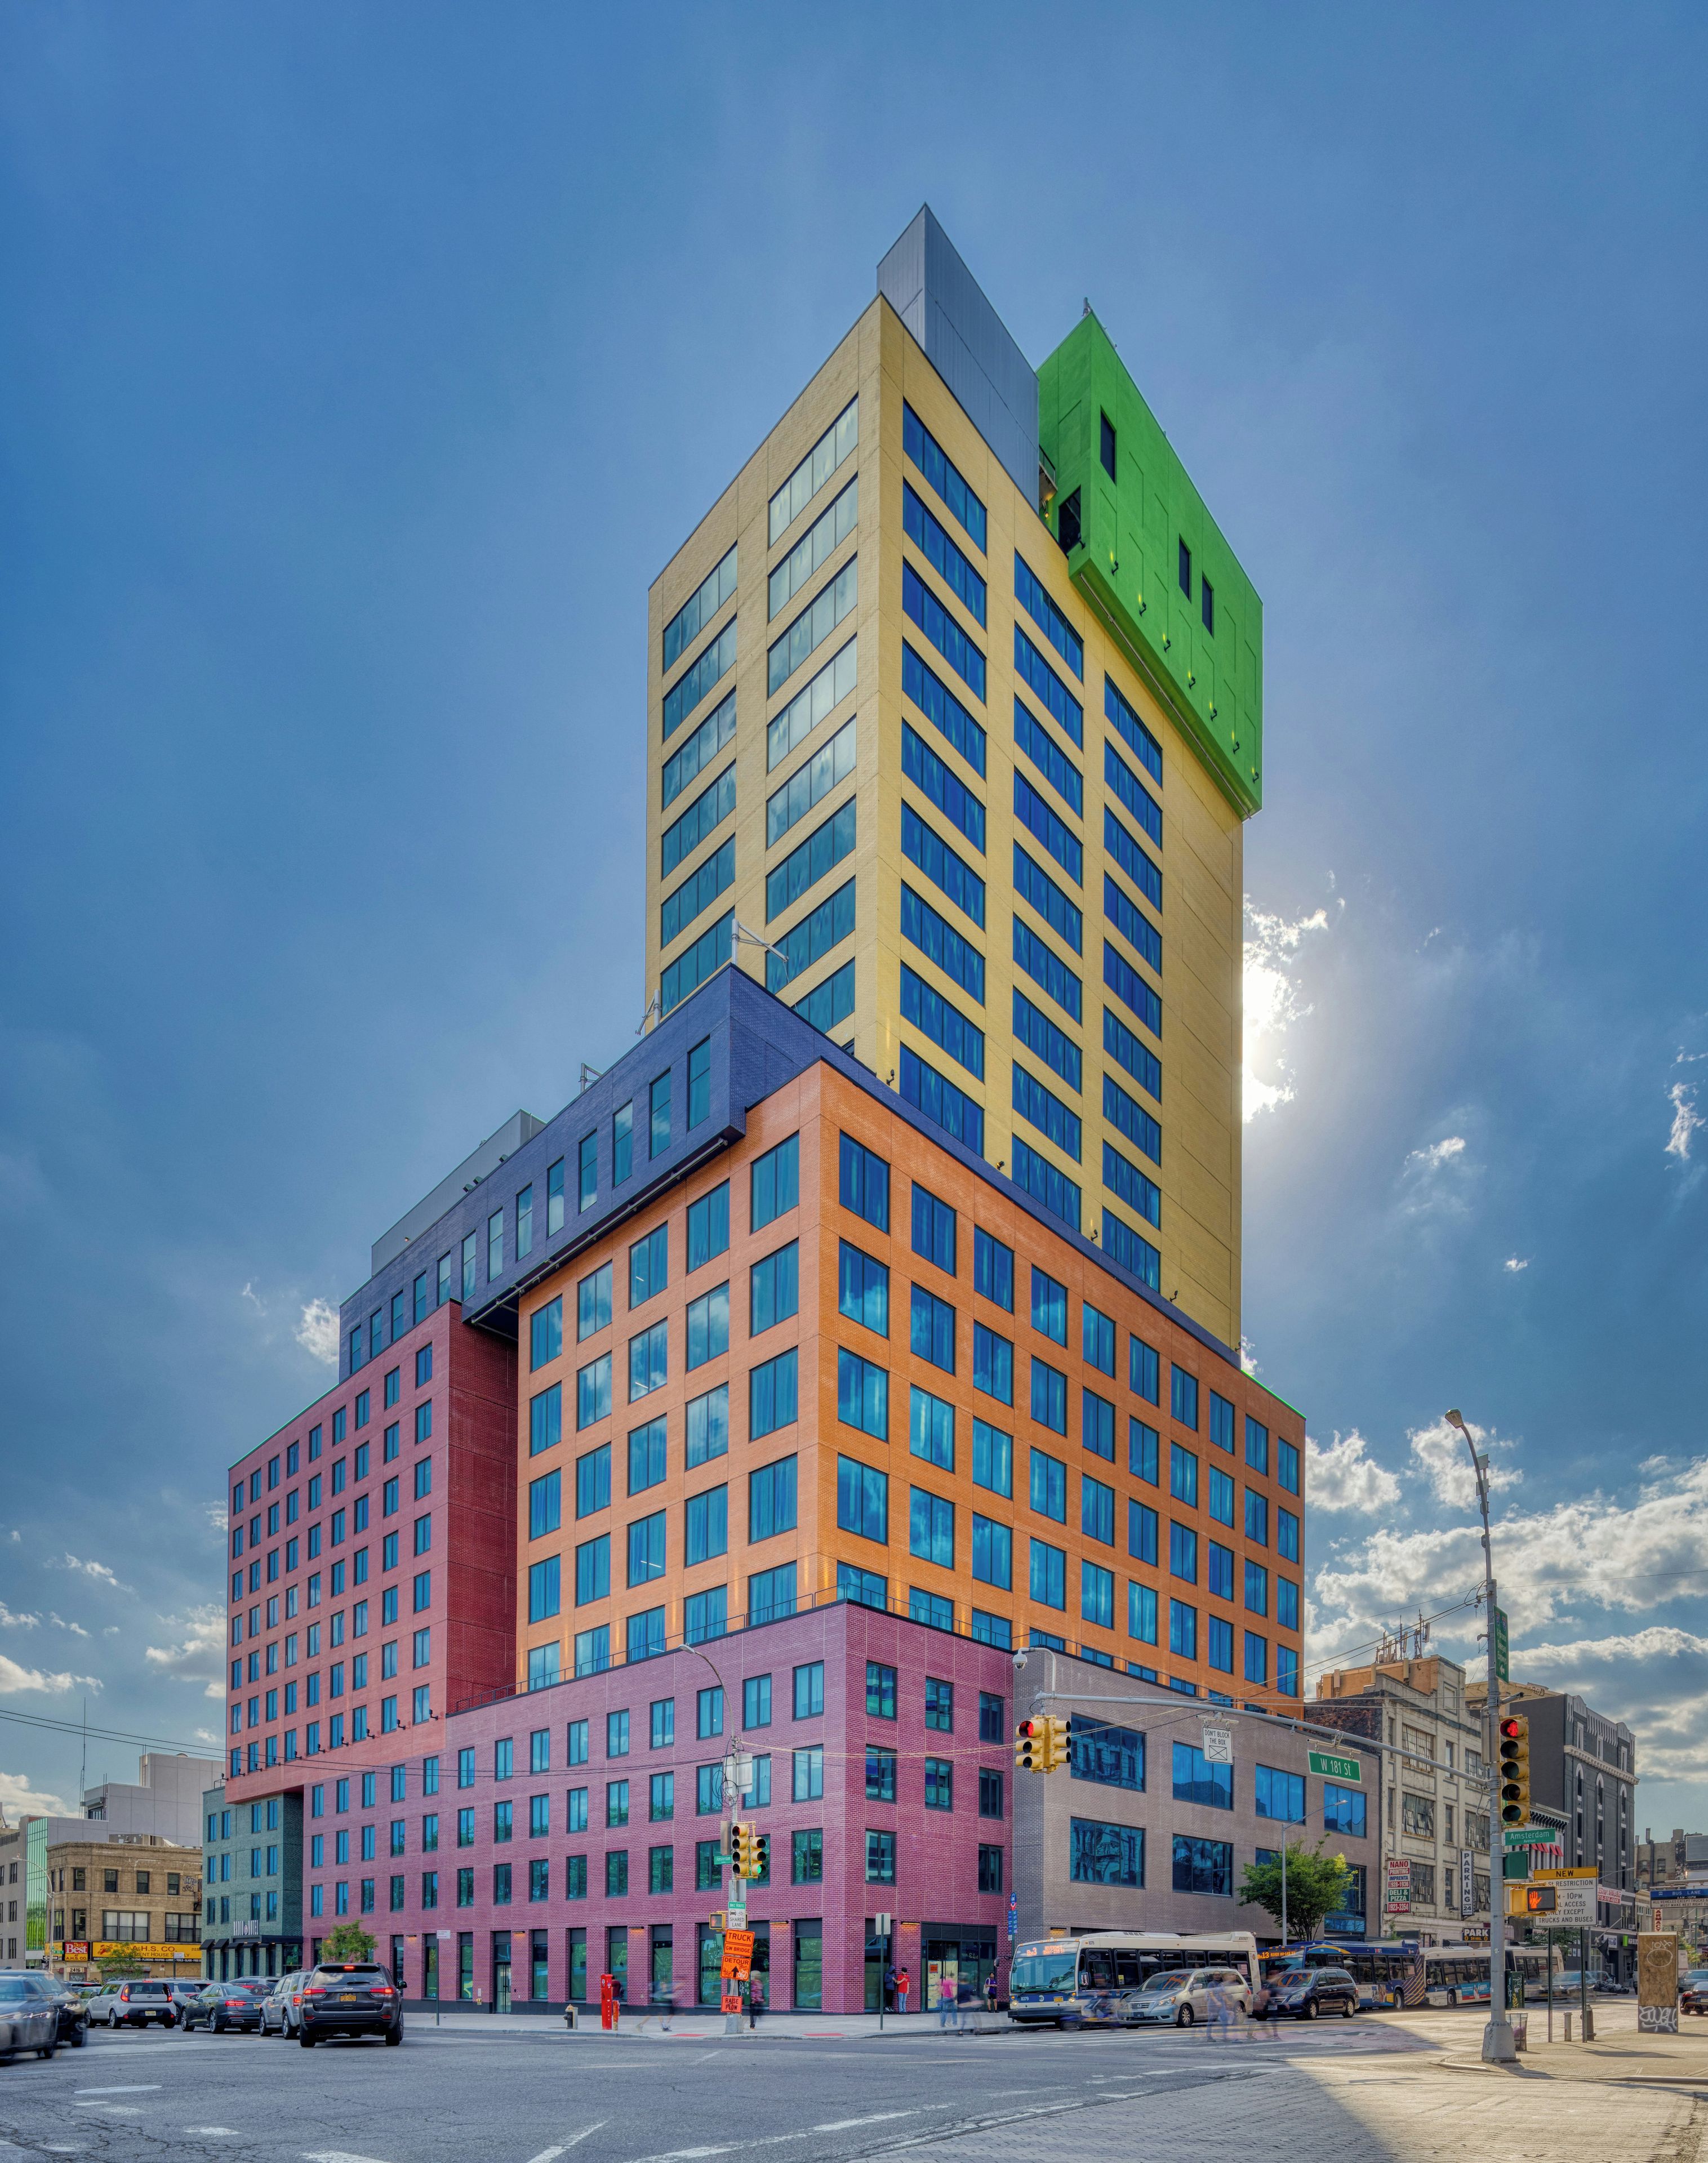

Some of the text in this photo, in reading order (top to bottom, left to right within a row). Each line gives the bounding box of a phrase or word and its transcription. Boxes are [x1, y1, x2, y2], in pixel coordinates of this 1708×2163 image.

[1217, 1730, 1230, 1739] BLOCK
[1320, 1757, 1351, 1776] W 181 St
[1510, 1831, 1549, 1840] Amsterdam
[728, 1932, 752, 1942] TRUCK
[65, 1944, 88, 1954] Best
[1026, 1947, 1037, 1956] Bx3
[724, 1957, 749, 1965] DETOUR
